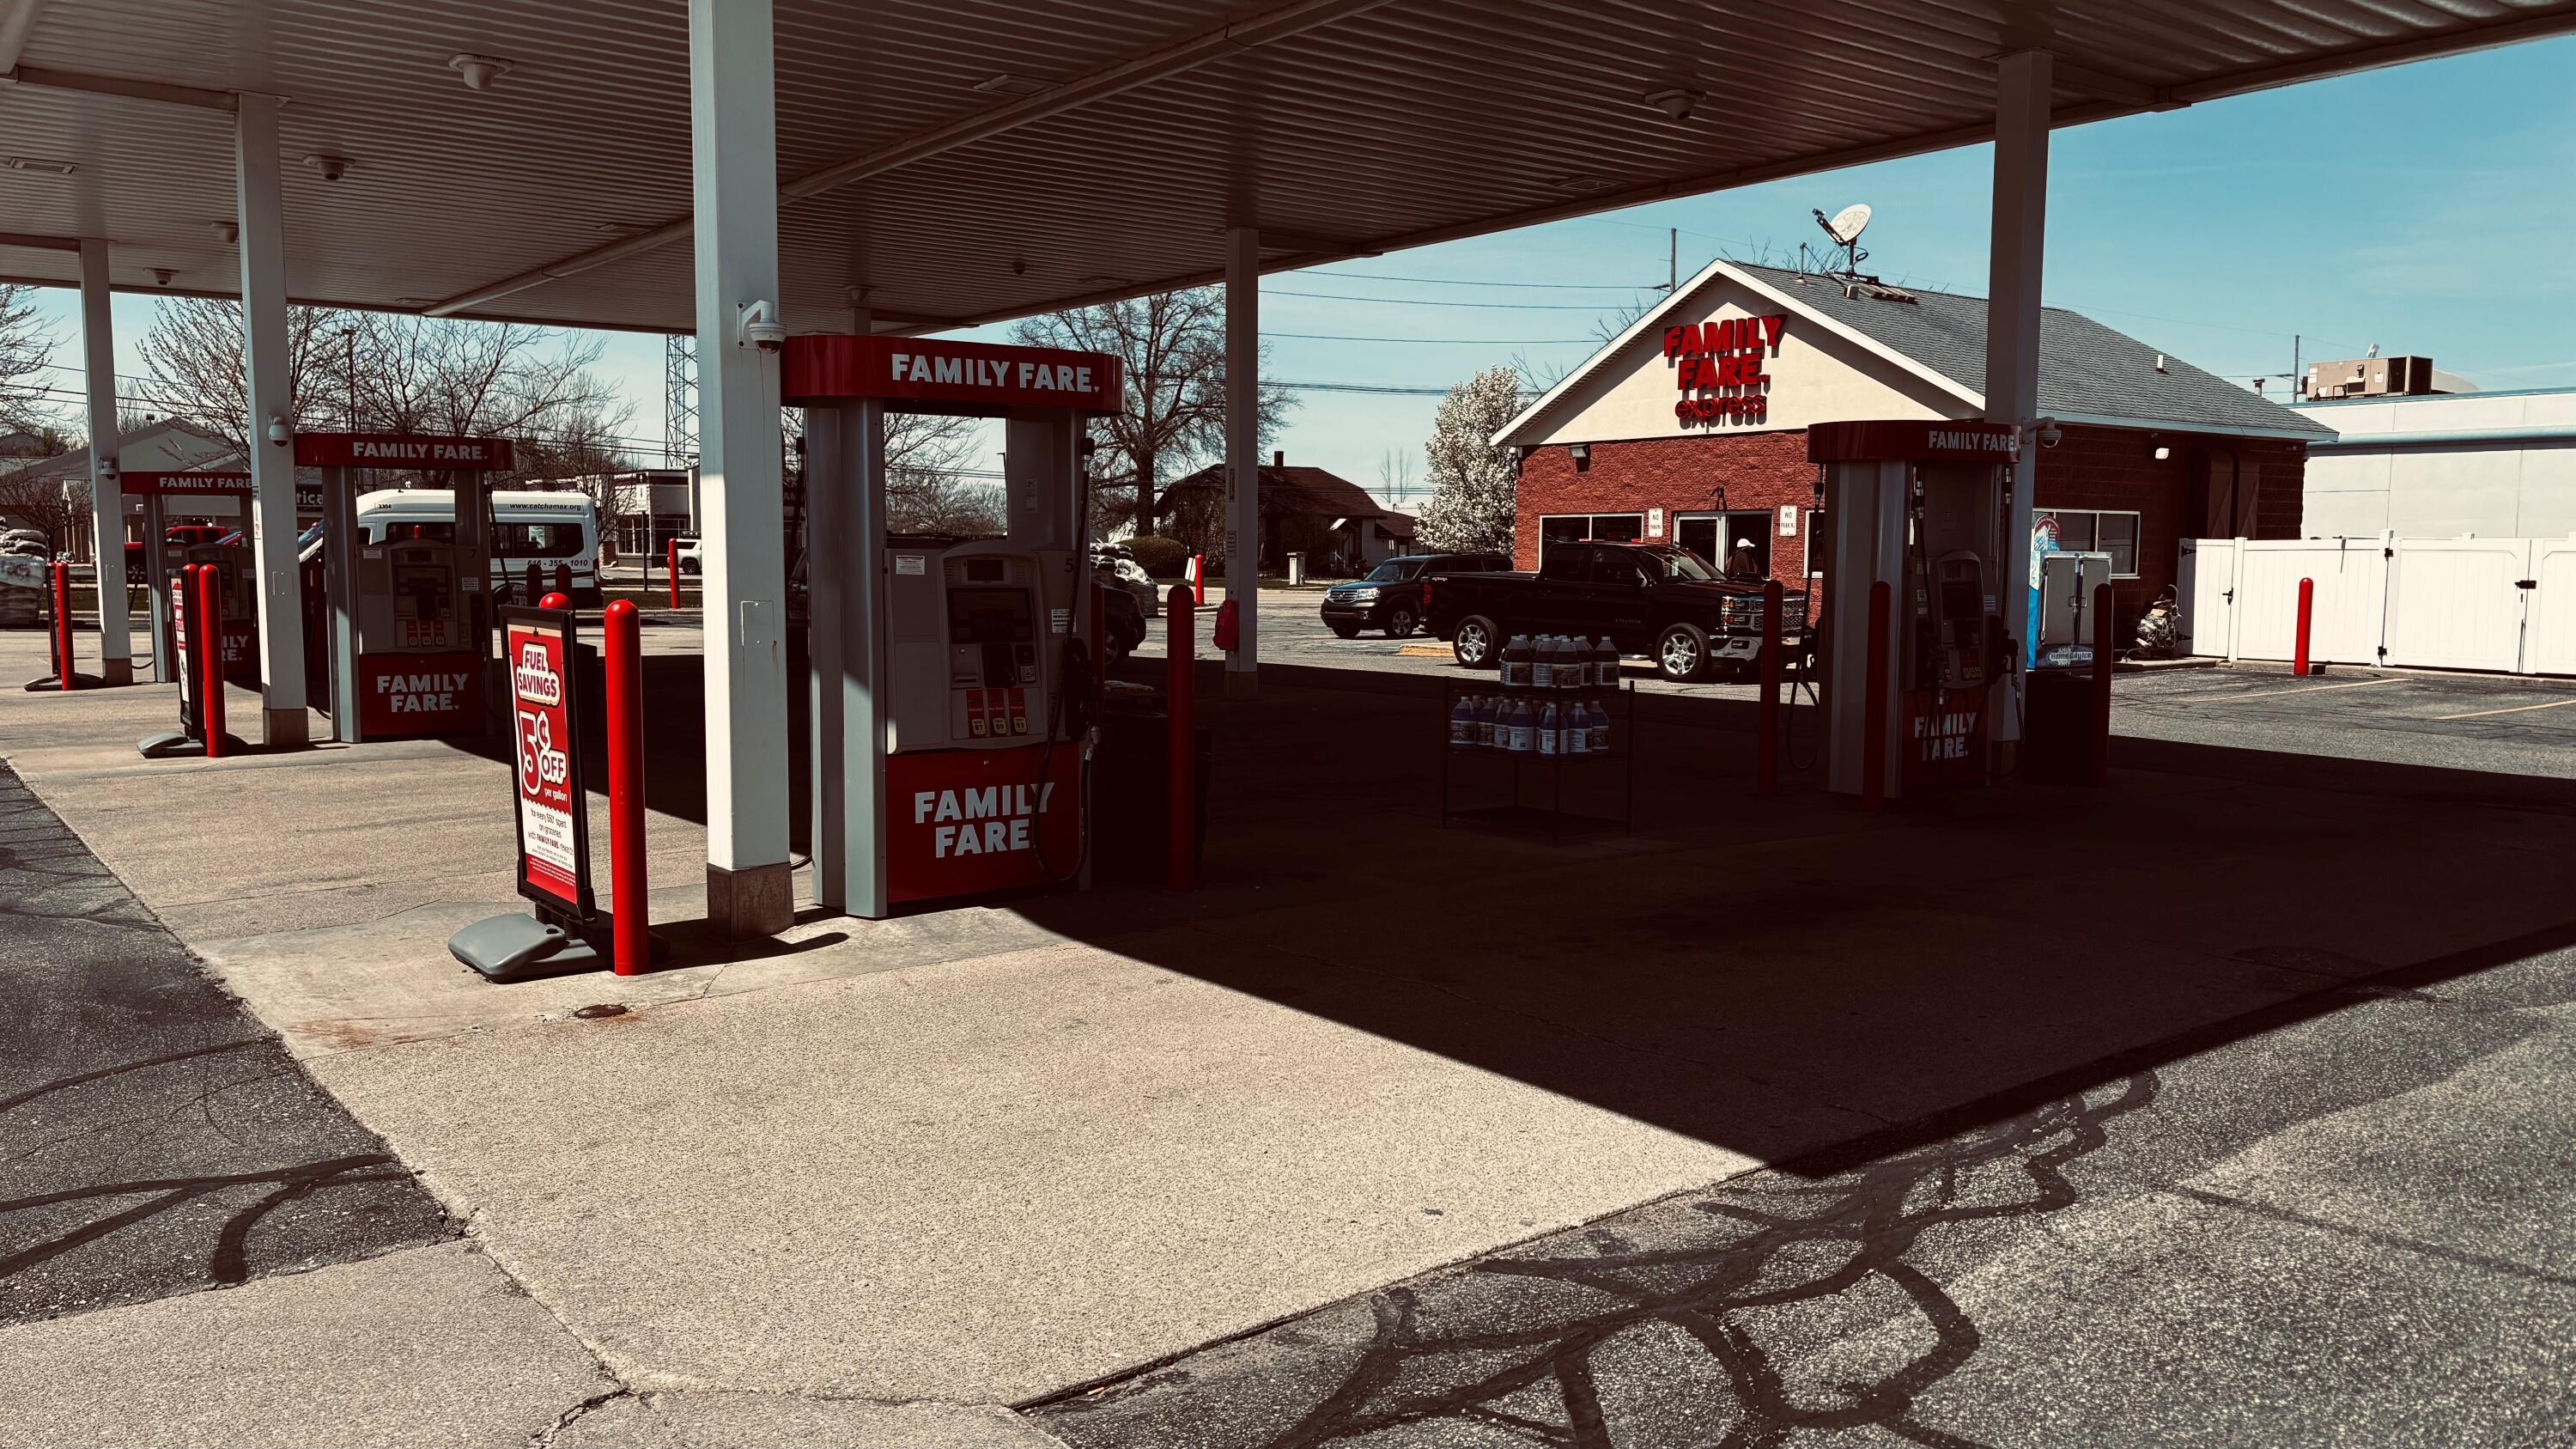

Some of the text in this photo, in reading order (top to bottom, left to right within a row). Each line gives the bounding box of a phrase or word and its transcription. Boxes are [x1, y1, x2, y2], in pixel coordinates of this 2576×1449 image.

[1664, 314, 1788, 357] FAMILY
[891, 353, 1011, 387] FAMILY
[1674, 394, 1767, 423] express
[353, 441, 428, 460] FAMILY
[1929, 430, 1980, 450] FAMILY
[159, 477, 214, 489] FAMILY
[295, 490, 324, 505] tica
[509, 502, 581, 511] www.catchamax.org
[1065, 557, 1073, 573] 5
[222, 635, 249, 648] ILY
[525, 650, 546, 672] FUEL
[377, 673, 469, 693] FAMILY
[518, 673, 557, 697] SAVINGS
[1915, 712, 1978, 739] FAMILY
[541, 753, 565, 780] OFF
[544, 788, 568, 801] per gallon
[914, 782, 1055, 825] FAMILY
[935, 818, 1030, 858] FARE
